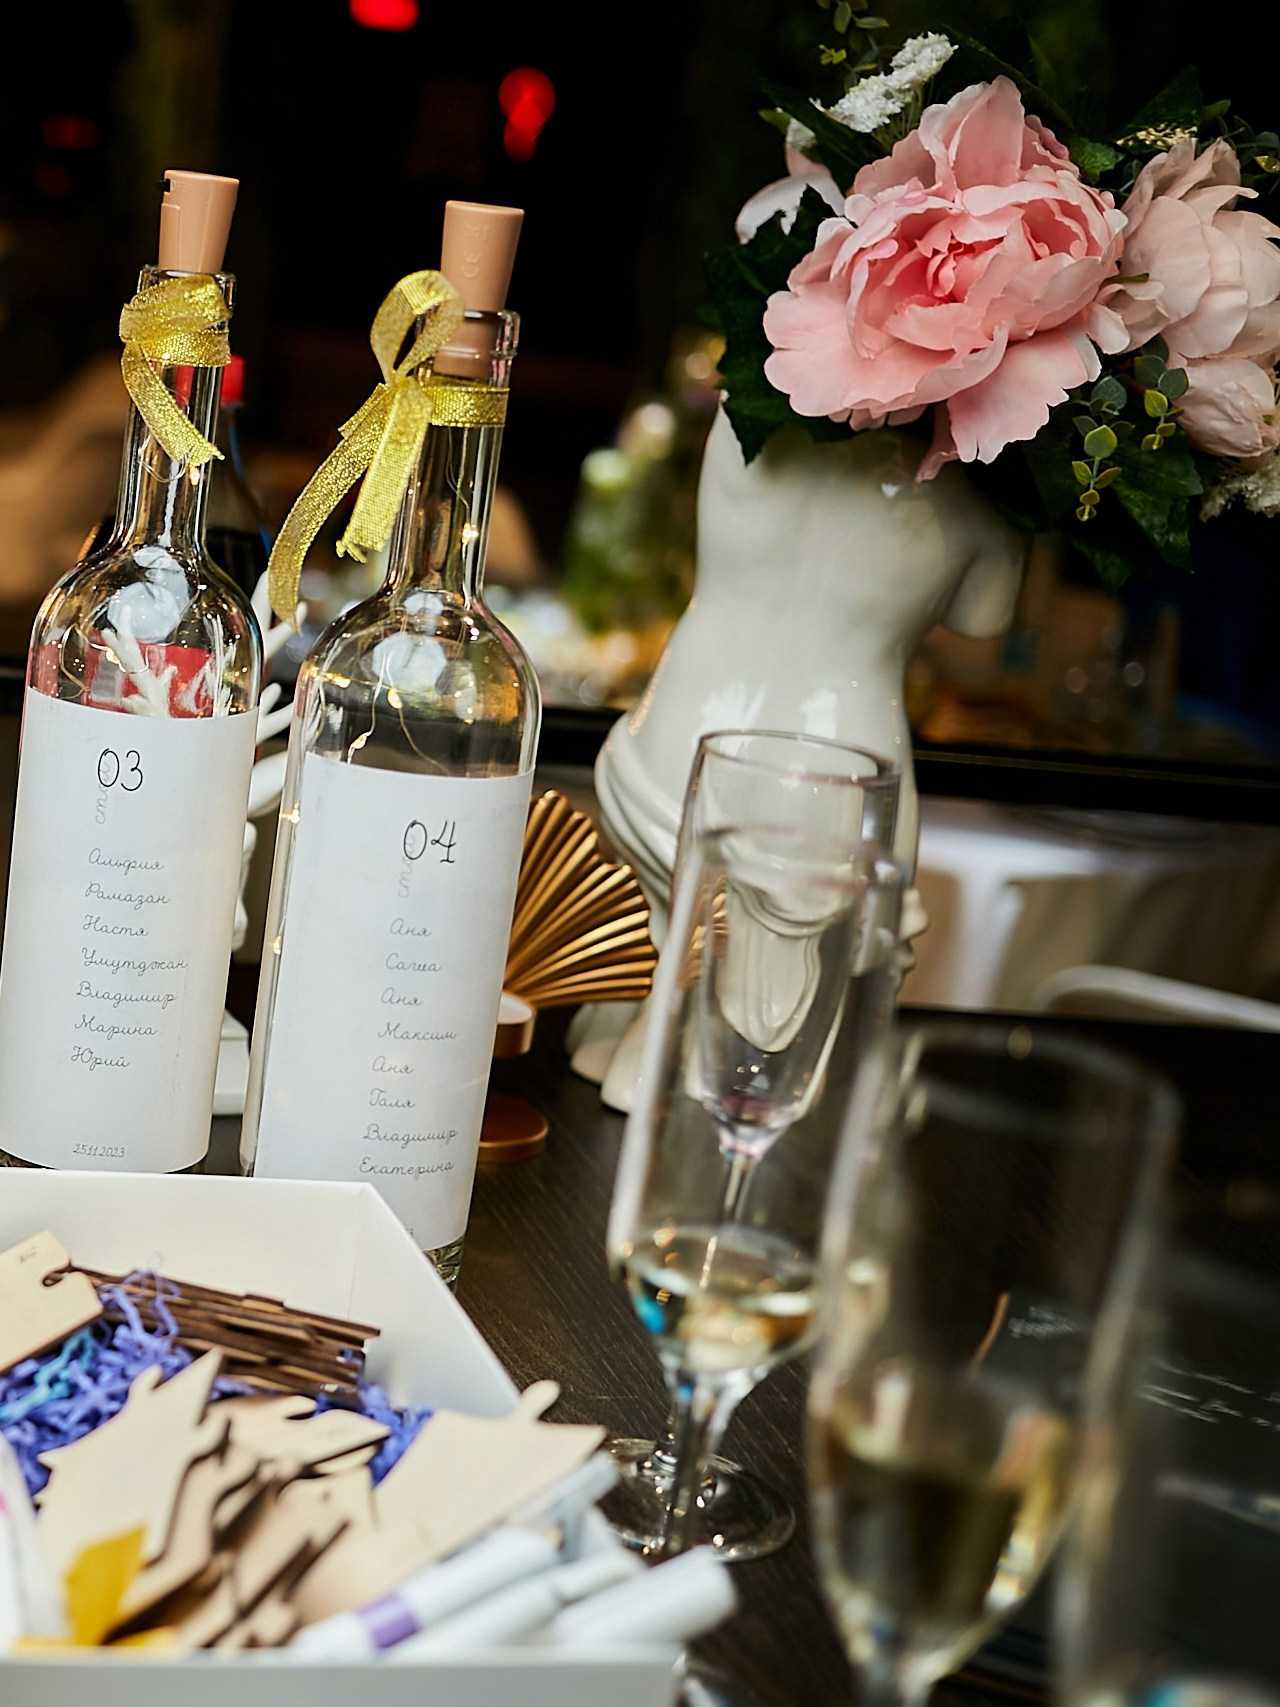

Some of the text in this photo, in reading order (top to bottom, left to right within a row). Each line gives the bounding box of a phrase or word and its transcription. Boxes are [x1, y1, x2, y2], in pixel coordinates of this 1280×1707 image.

[96, 747, 144, 793] 03
[402, 818, 457, 865] 04
[87, 847, 165, 877] Альфия
[84, 880, 171, 912] Рамазан
[81, 913, 150, 937] Настя
[389, 916, 433, 938] Аня
[384, 951, 443, 973] Саша
[75, 979, 178, 1011] Владимир
[380, 986, 424, 1007] Аня
[73, 1013, 159, 1042] Марина
[376, 1020, 459, 1042] Максим
[70, 1044, 131, 1073] Юрий
[371, 1054, 415, 1075] Аня
[368, 1087, 417, 1109] Галя
[361, 1122, 458, 1151] Владимир
[356, 1155, 454, 1183] Екатерина
